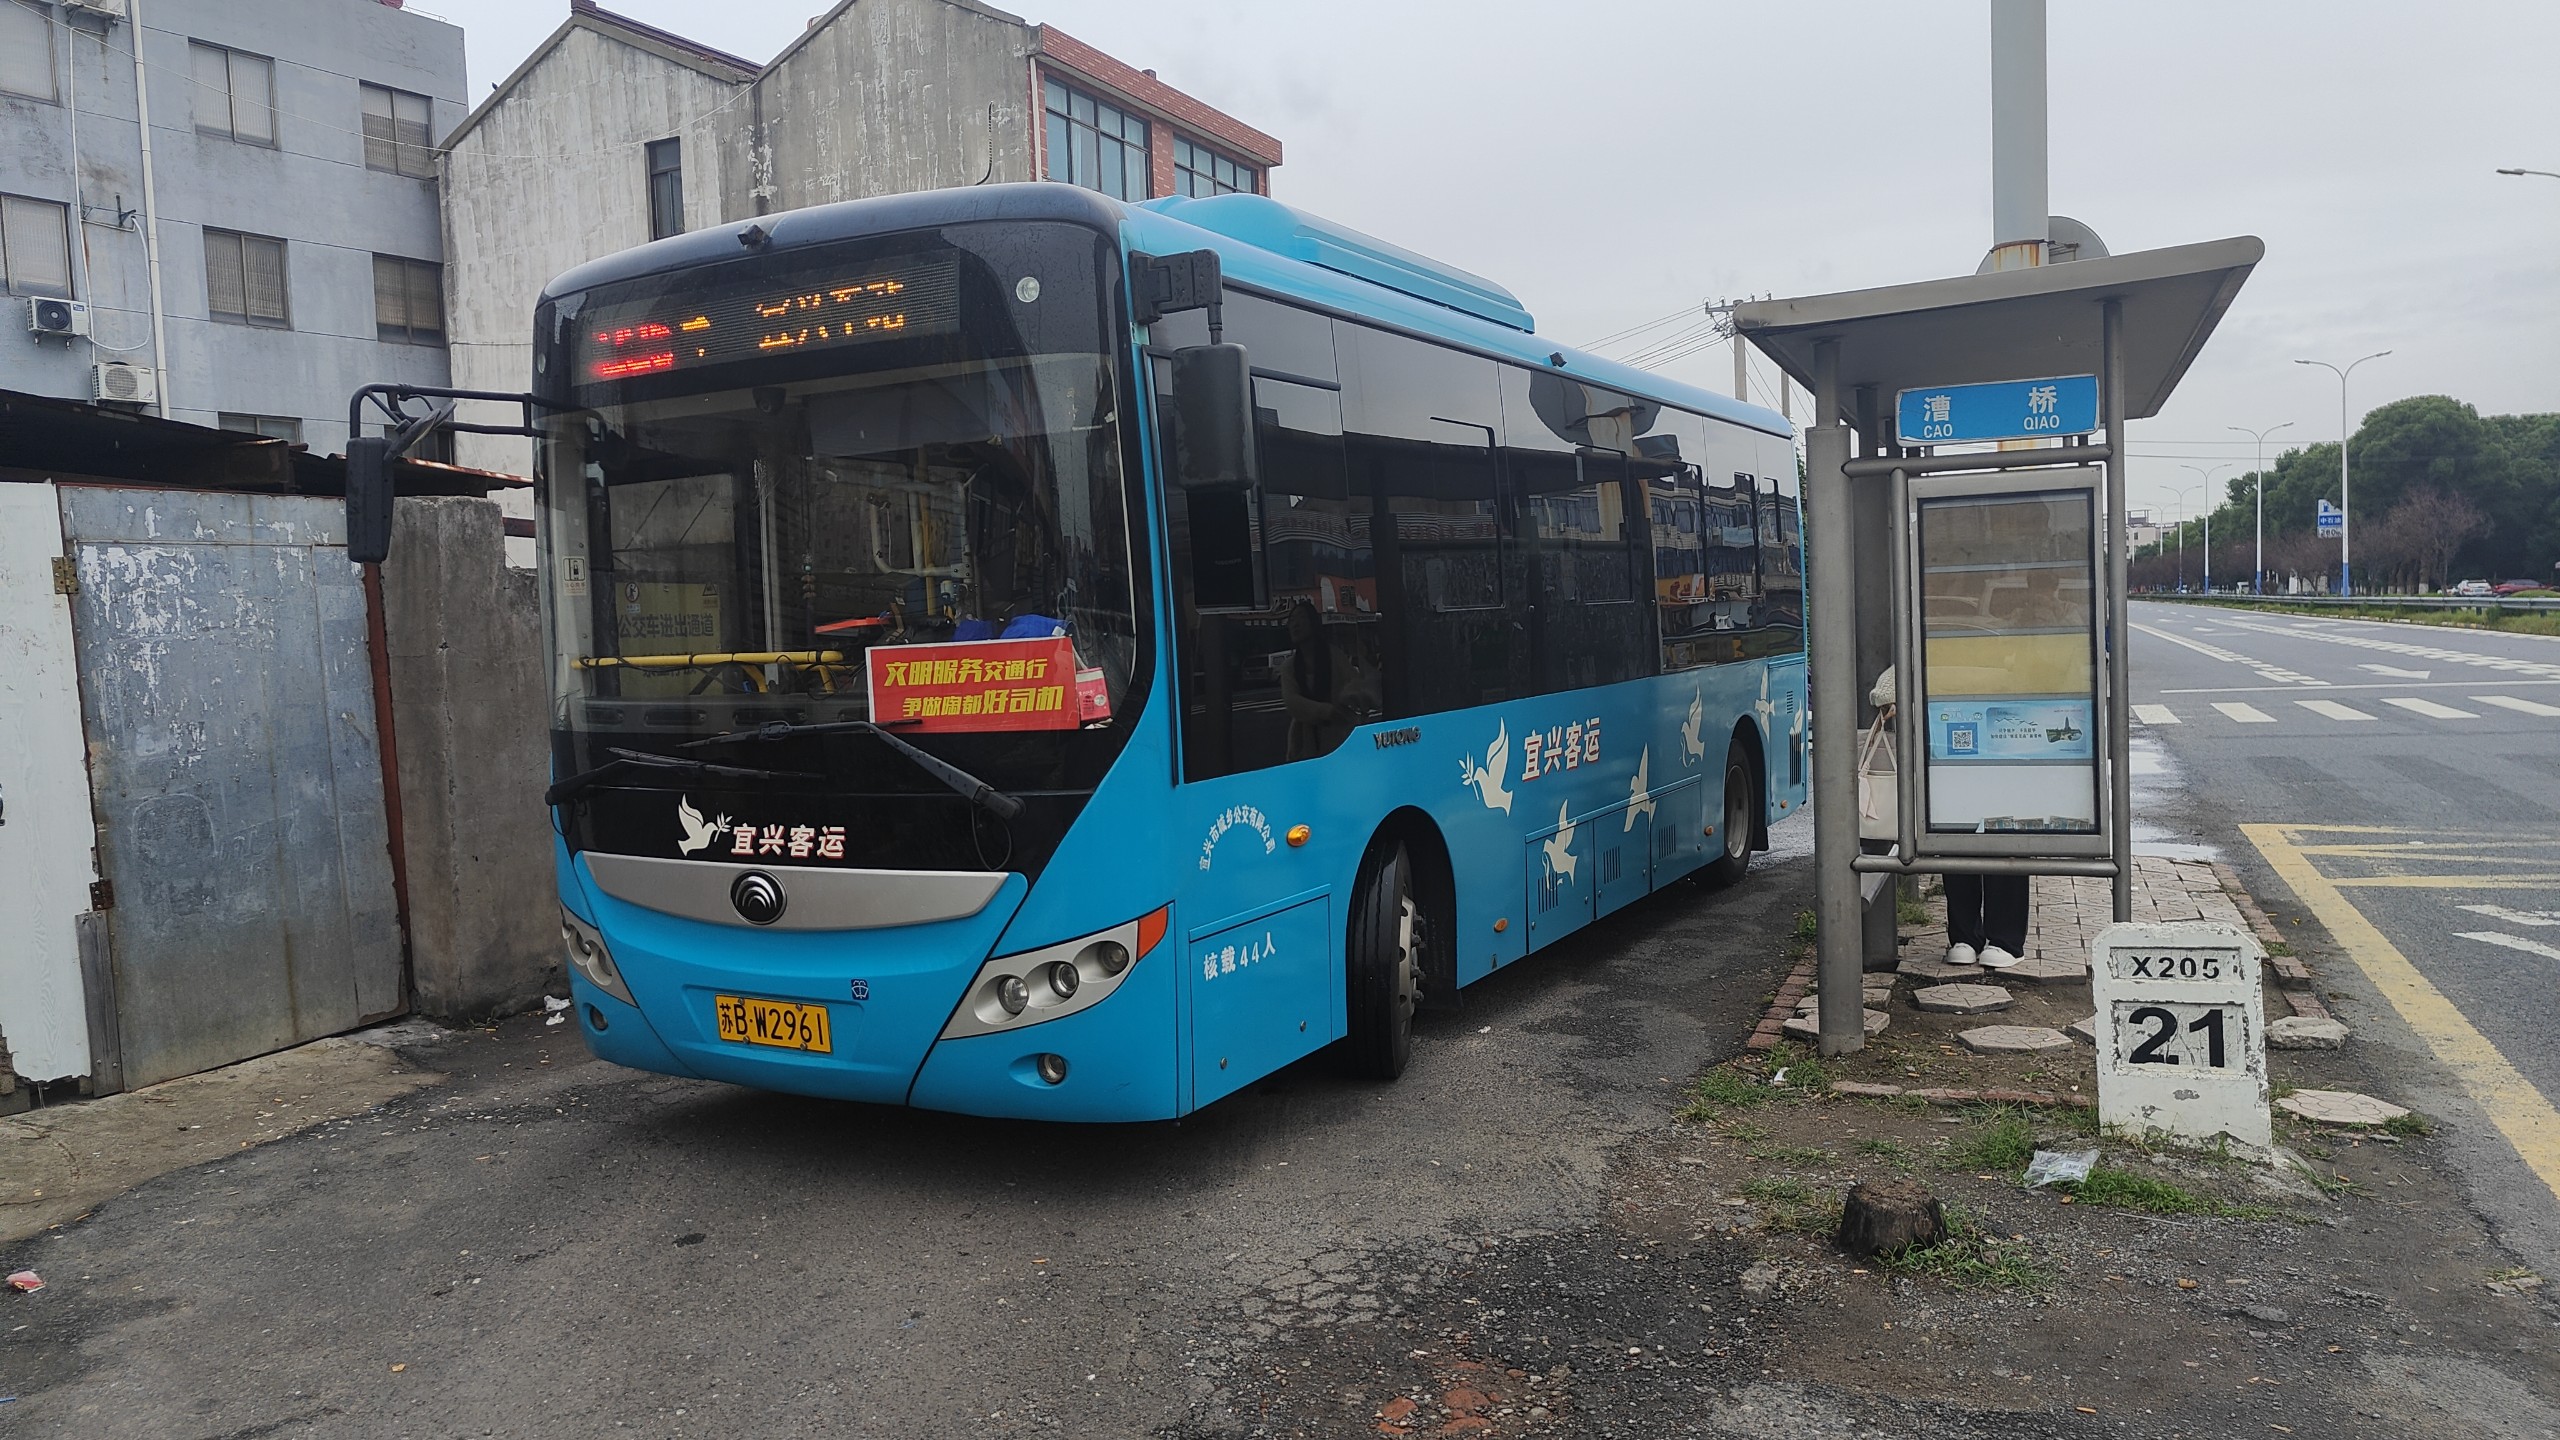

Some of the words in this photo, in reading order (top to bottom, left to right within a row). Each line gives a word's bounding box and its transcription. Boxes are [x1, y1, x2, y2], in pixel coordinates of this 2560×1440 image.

[1923, 394, 1952, 423] 漕
[2028, 385, 2058, 415] 桥
[1923, 422, 1953, 439] CAO
[2023, 414, 2060, 431] QIAO
[619, 612, 715, 639] 公交车进出通道
[883, 657, 1048, 687] 文明服务交通行
[902, 686, 1065, 718] 争做陶都好司机
[1373, 726, 1422, 750] YUTONG
[1521, 716, 1601, 782] 宜兴客运
[730, 822, 847, 859] 宜兴客运
[1199, 804, 1276, 872] 宜兴市城乡公交有限公司
[1203, 931, 1276, 982] 核载44人
[2131, 956, 2221, 979] X205
[2128, 1007, 2225, 1068] 21
